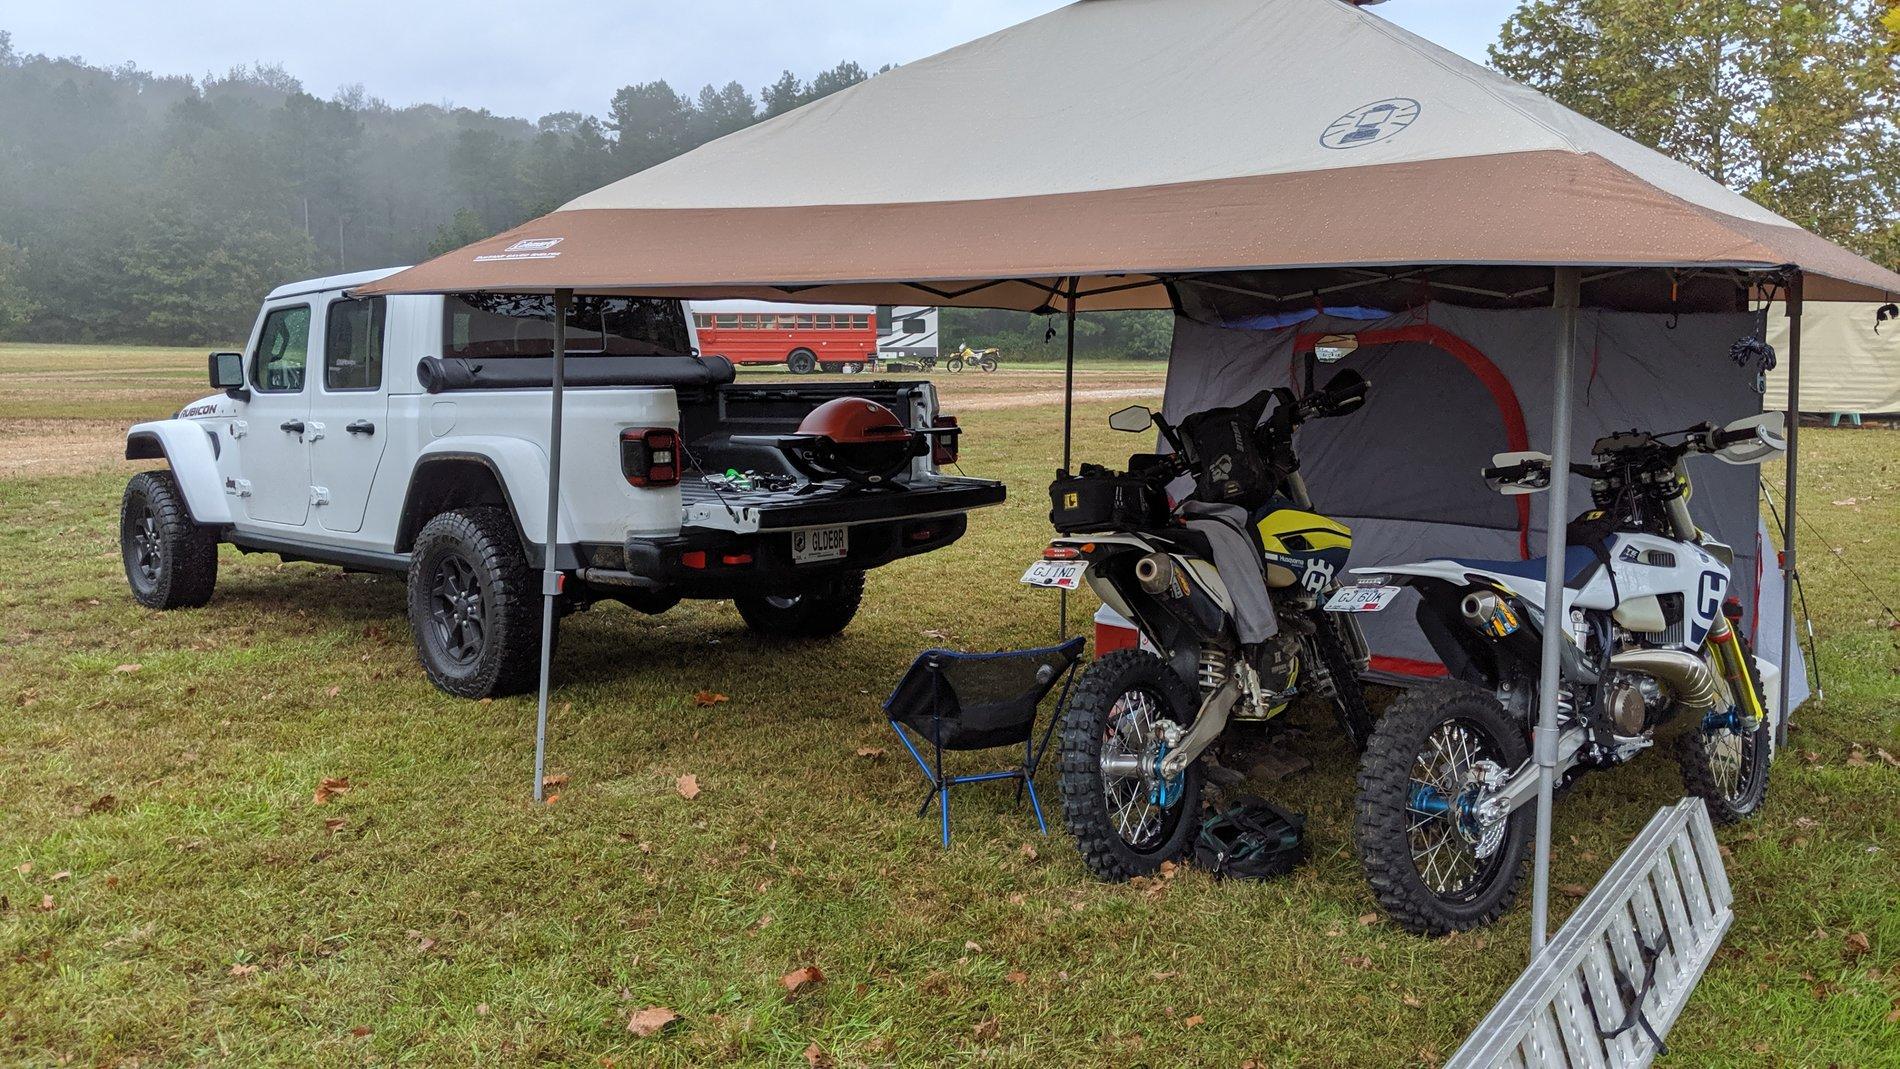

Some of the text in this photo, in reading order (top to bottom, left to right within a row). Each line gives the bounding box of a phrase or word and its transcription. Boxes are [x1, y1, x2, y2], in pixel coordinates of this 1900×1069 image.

[180, 404, 217, 418] RUBICON
[812, 528, 844, 551] GLDE8R
[1033, 566, 1051, 578] GJ
